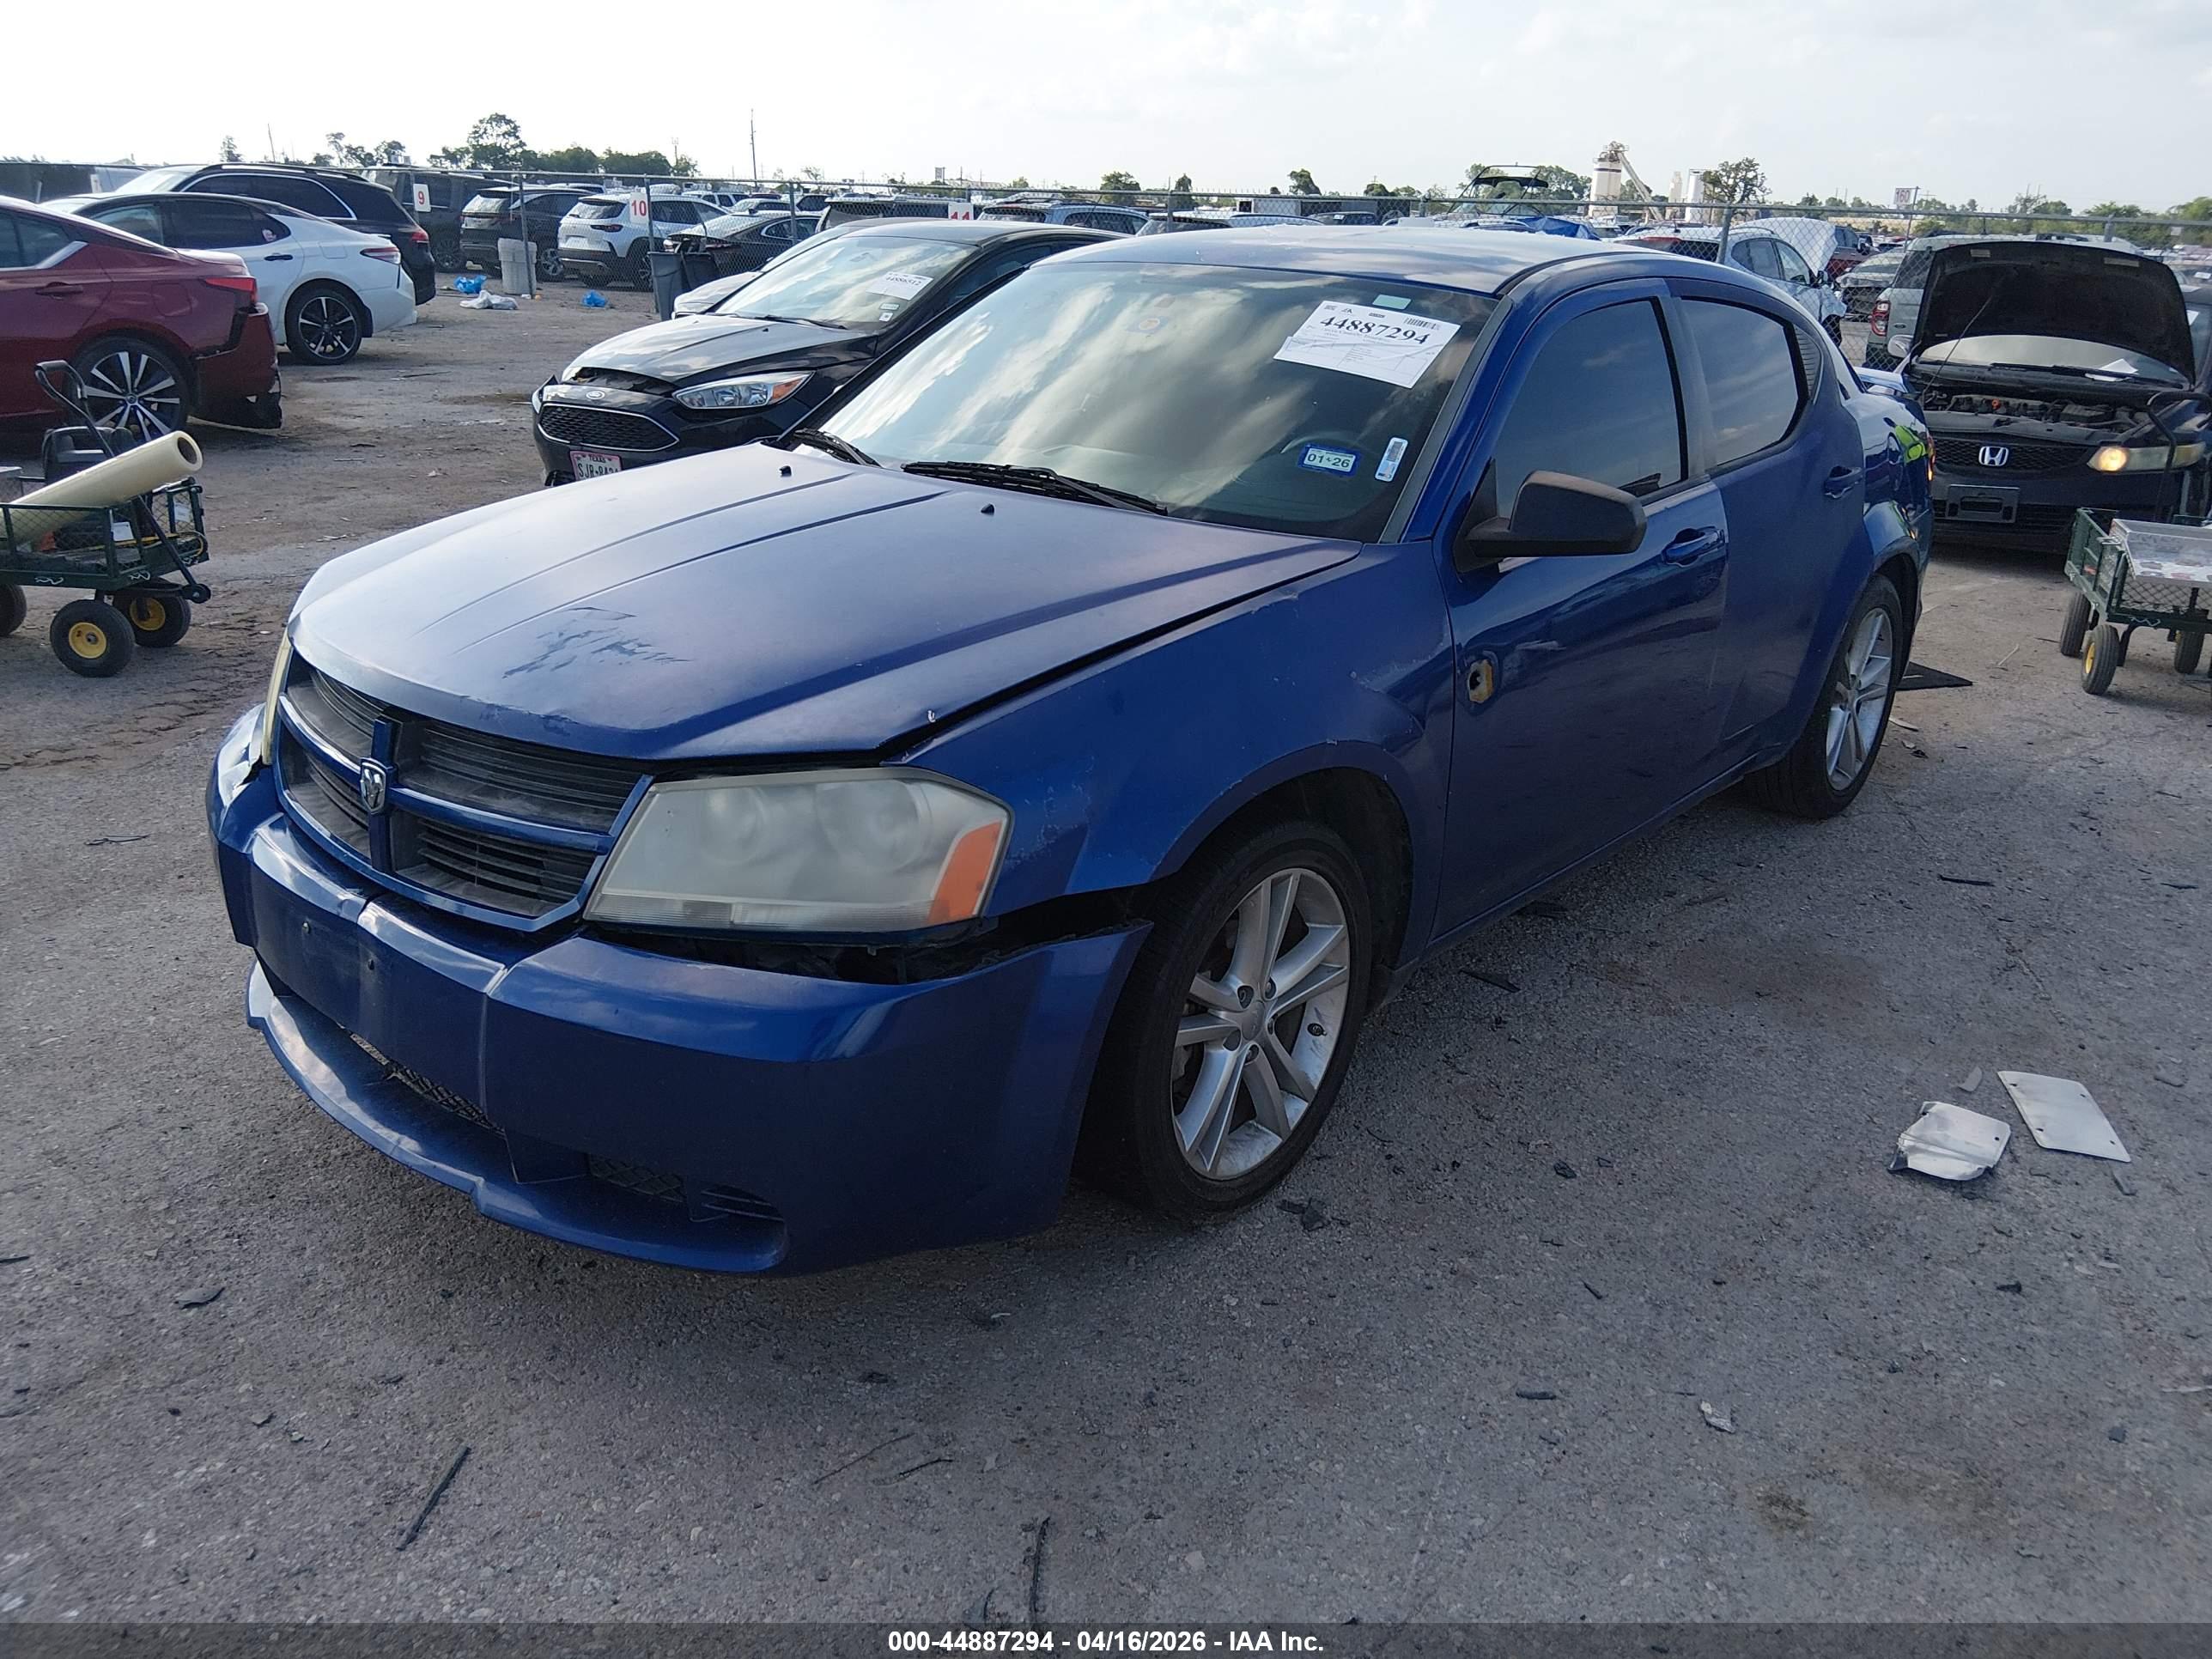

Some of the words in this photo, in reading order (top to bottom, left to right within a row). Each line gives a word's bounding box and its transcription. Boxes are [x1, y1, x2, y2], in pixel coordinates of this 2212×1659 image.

[417, 191, 425, 205] 9
[631, 199, 647, 216] 10
[1320, 316, 1431, 345] 44887294
[1307, 453, 1323, 464] 01
[1332, 458, 1351, 468] 26
